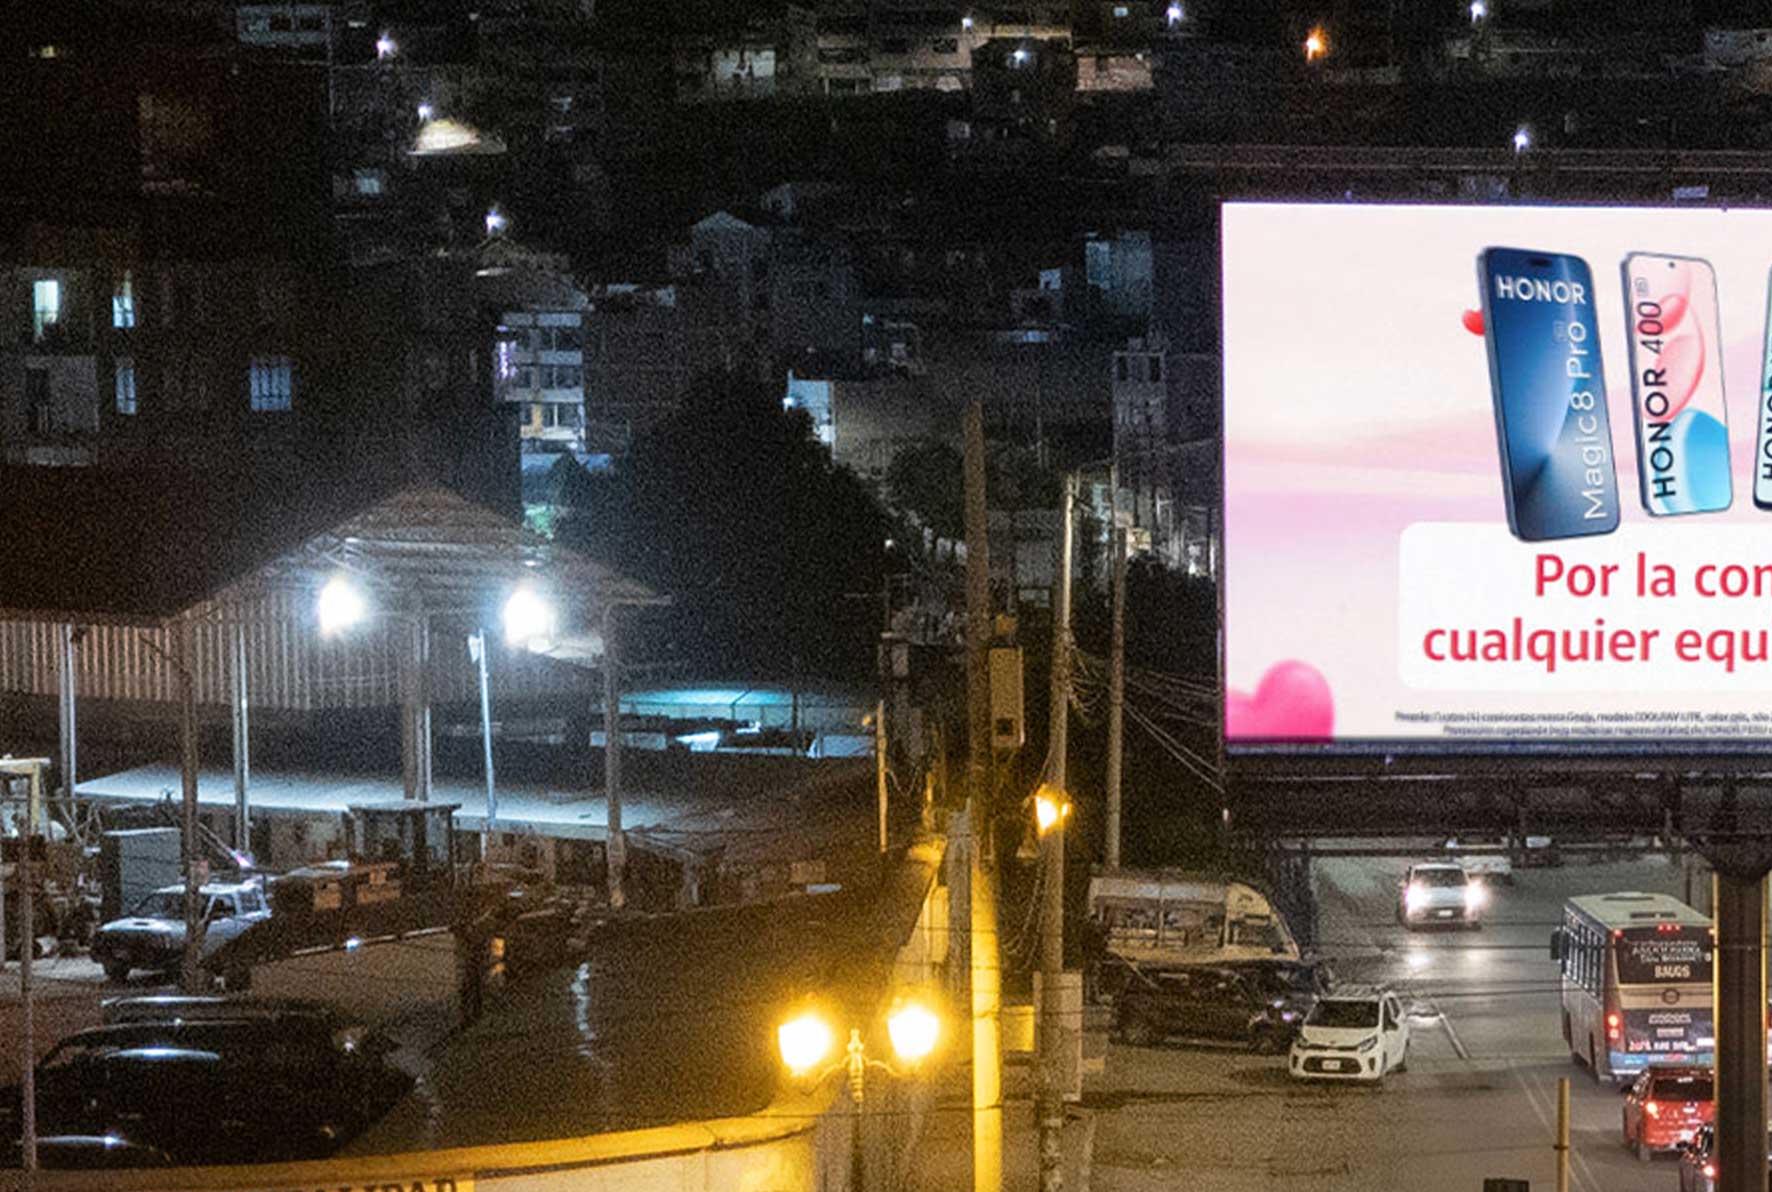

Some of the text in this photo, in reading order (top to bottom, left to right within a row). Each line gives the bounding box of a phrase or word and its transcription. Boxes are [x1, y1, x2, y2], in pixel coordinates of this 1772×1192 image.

[1496, 275, 1587, 304] HONOR
[1637, 301, 1665, 355] 400
[1566, 321, 1608, 520] Magic8 Pro
[1642, 368, 1676, 498] HONOR
[1535, 552, 1618, 598] Por
[1636, 551, 1677, 598] la
[1423, 616, 1660, 673] cualquier
